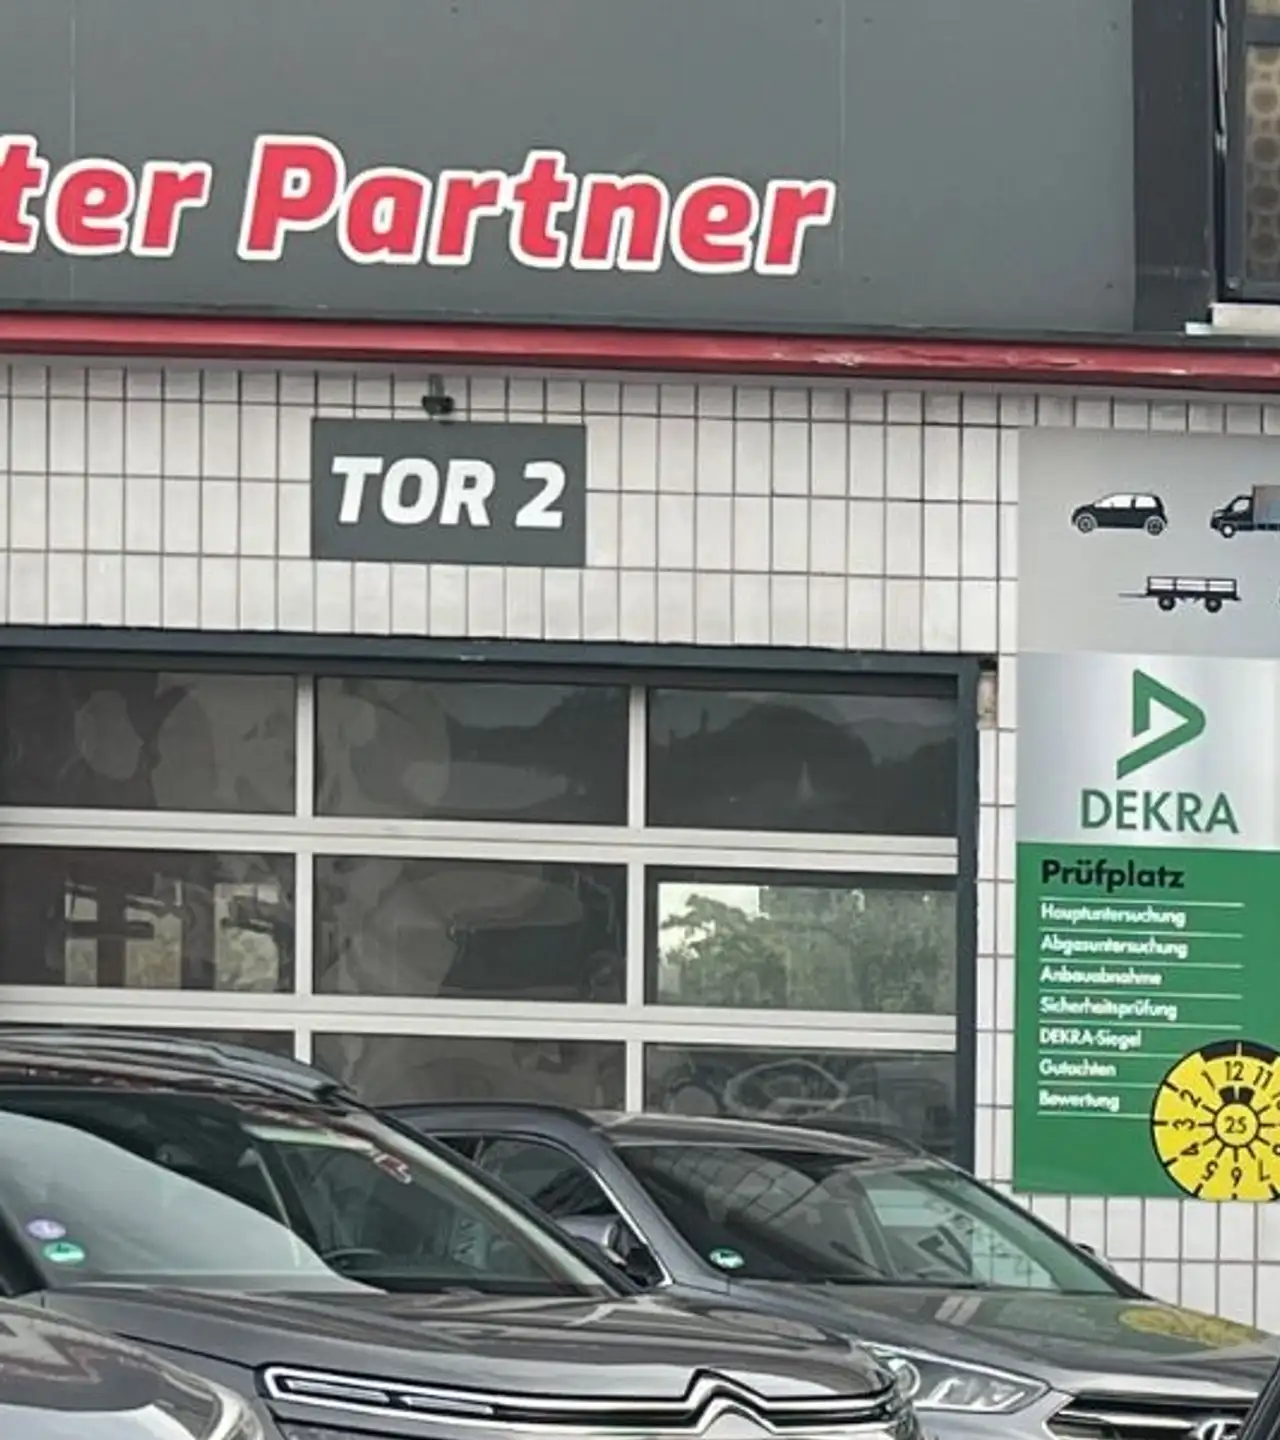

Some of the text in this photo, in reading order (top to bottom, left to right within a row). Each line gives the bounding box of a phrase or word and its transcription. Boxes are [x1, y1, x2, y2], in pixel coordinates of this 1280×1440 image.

[239, 134, 837, 275] Partner
[331, 455, 566, 529] TOR 2
[1080, 788, 1240, 835] DEKRA
[1041, 858, 1185, 893] Prüfplatz
[1040, 903, 1187, 928] Hauptuntersuchung
[1040, 934, 1188, 959] Abgasuntersuchung
[1040, 965, 1162, 986] Anbauabnahme
[1039, 997, 1178, 1021] Sicherheitsprüfung
[1039, 1028, 1142, 1051] DEKRA-Siegel
[1039, 1058, 1117, 1078] Gutachten
[1224, 1061, 1245, 1081] 12
[1253, 1066, 1273, 1091] 11
[1200, 1070, 1216, 1090] 1
[1039, 1090, 1120, 1112] Bewertung
[1179, 1089, 1202, 1108] 2
[1172, 1118, 1196, 1131] 3
[1224, 1116, 1248, 1134] 25
[1180, 1142, 1199, 1155] 4
[1202, 1160, 1218, 1181] 5
[1231, 1166, 1242, 1187] 6
[1259, 1160, 1271, 1182] 7
